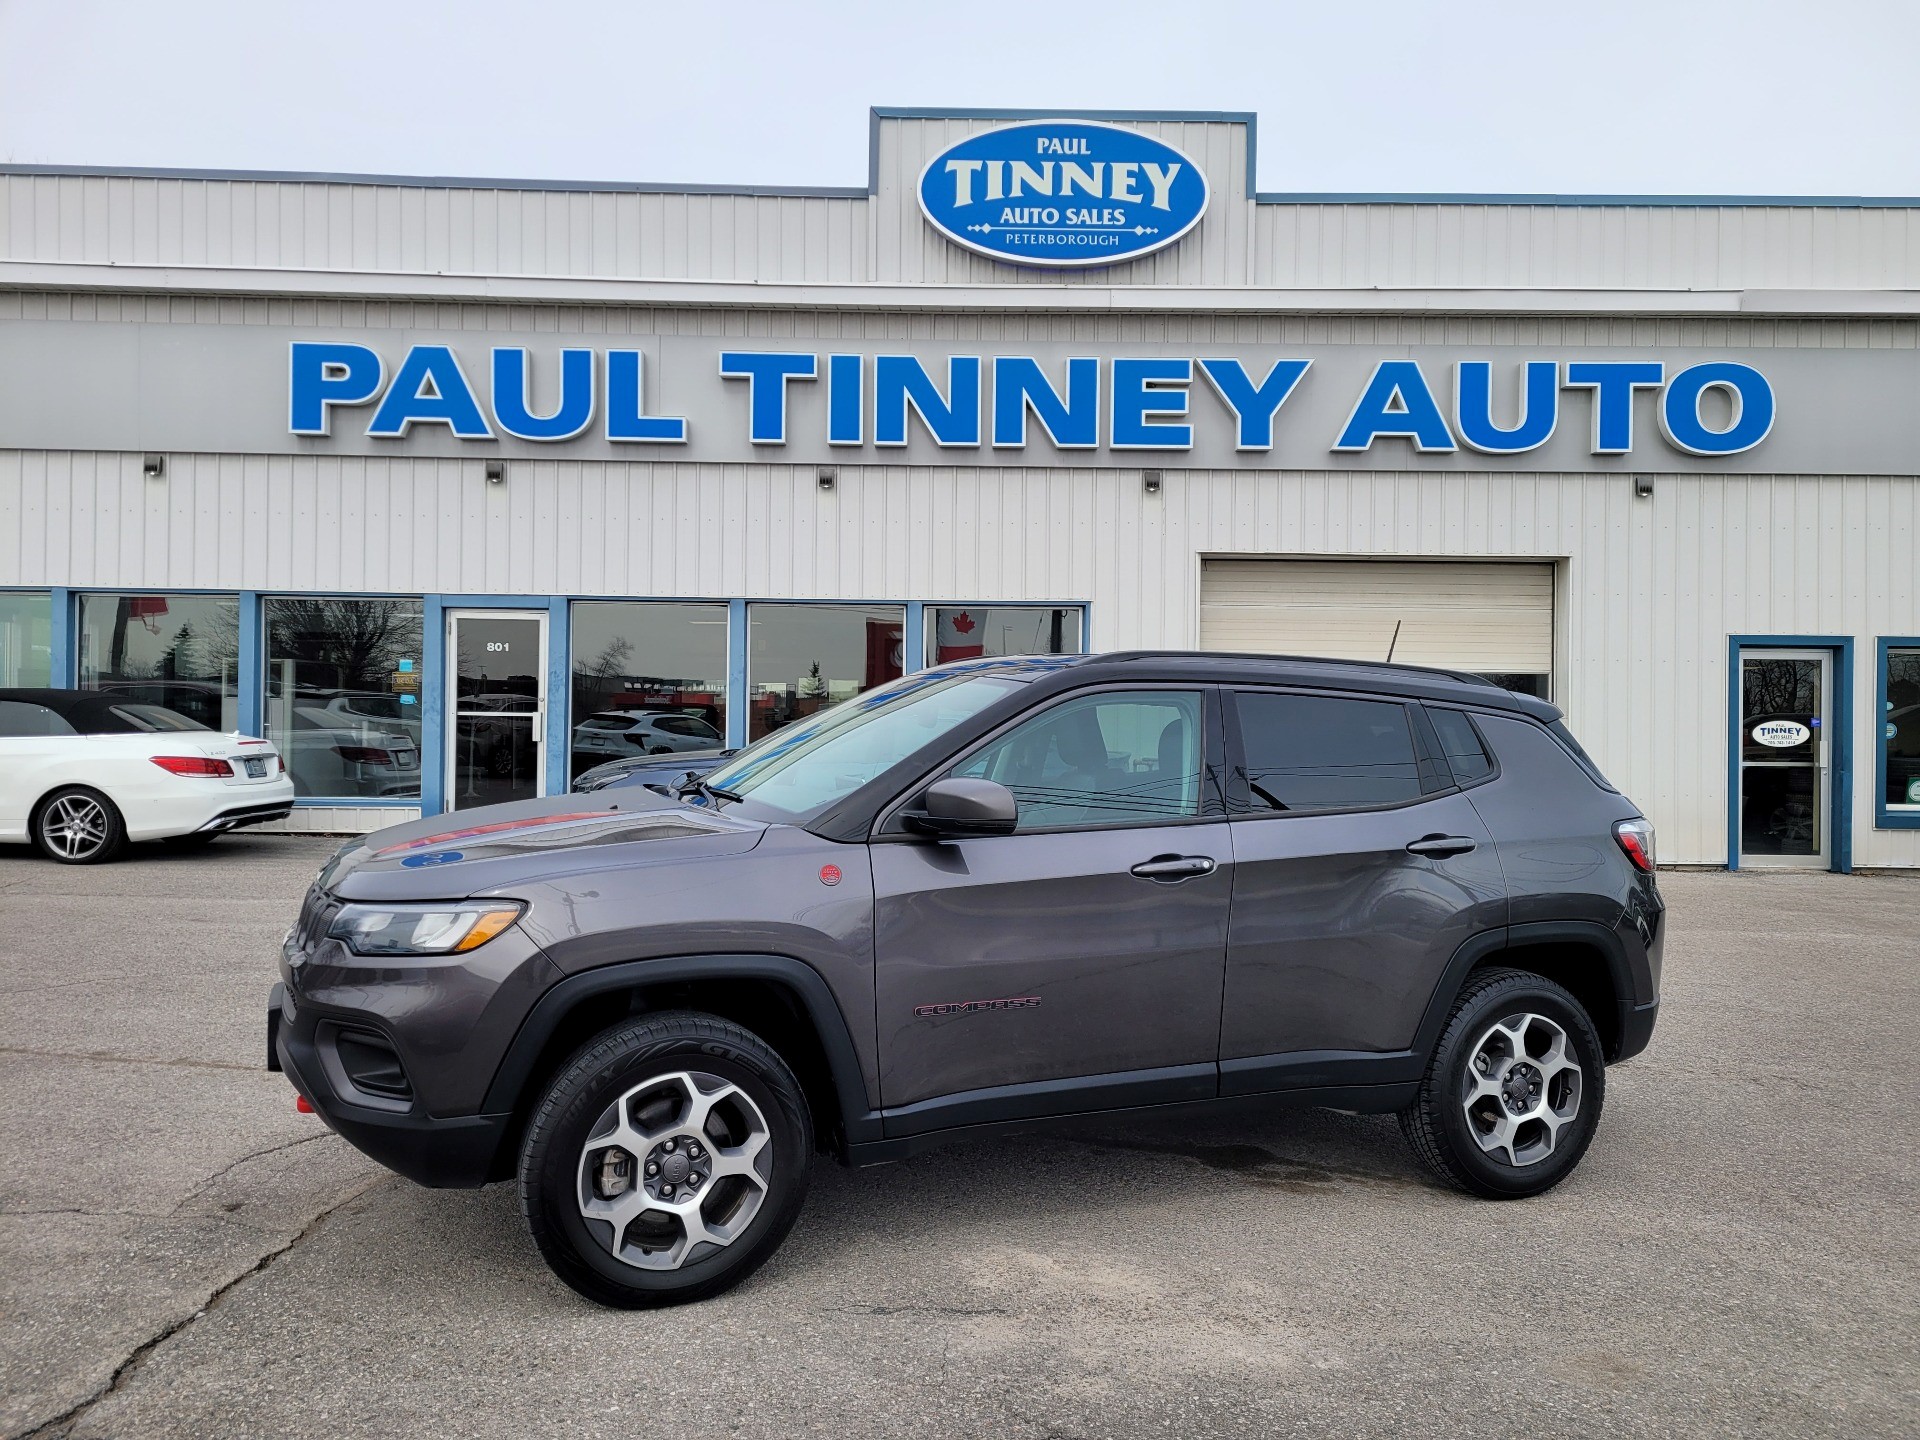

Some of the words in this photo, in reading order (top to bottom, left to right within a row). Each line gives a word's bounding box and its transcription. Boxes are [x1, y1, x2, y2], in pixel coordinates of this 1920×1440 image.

[1037, 137, 1091, 155] PAUL
[944, 159, 1183, 212] TINNEY
[999, 207, 1060, 225] AUTO
[1066, 208, 1126, 225] SALES
[1006, 233, 1119, 246] PETERBOROUGH
[288, 341, 689, 444] PAUL
[718, 350, 1315, 452] TINNEY
[1329, 358, 1777, 457] AUTO
[486, 642, 509, 652] 801
[1760, 727, 1801, 736] TINNEY
[914, 997, 1042, 1017] COMPASS
